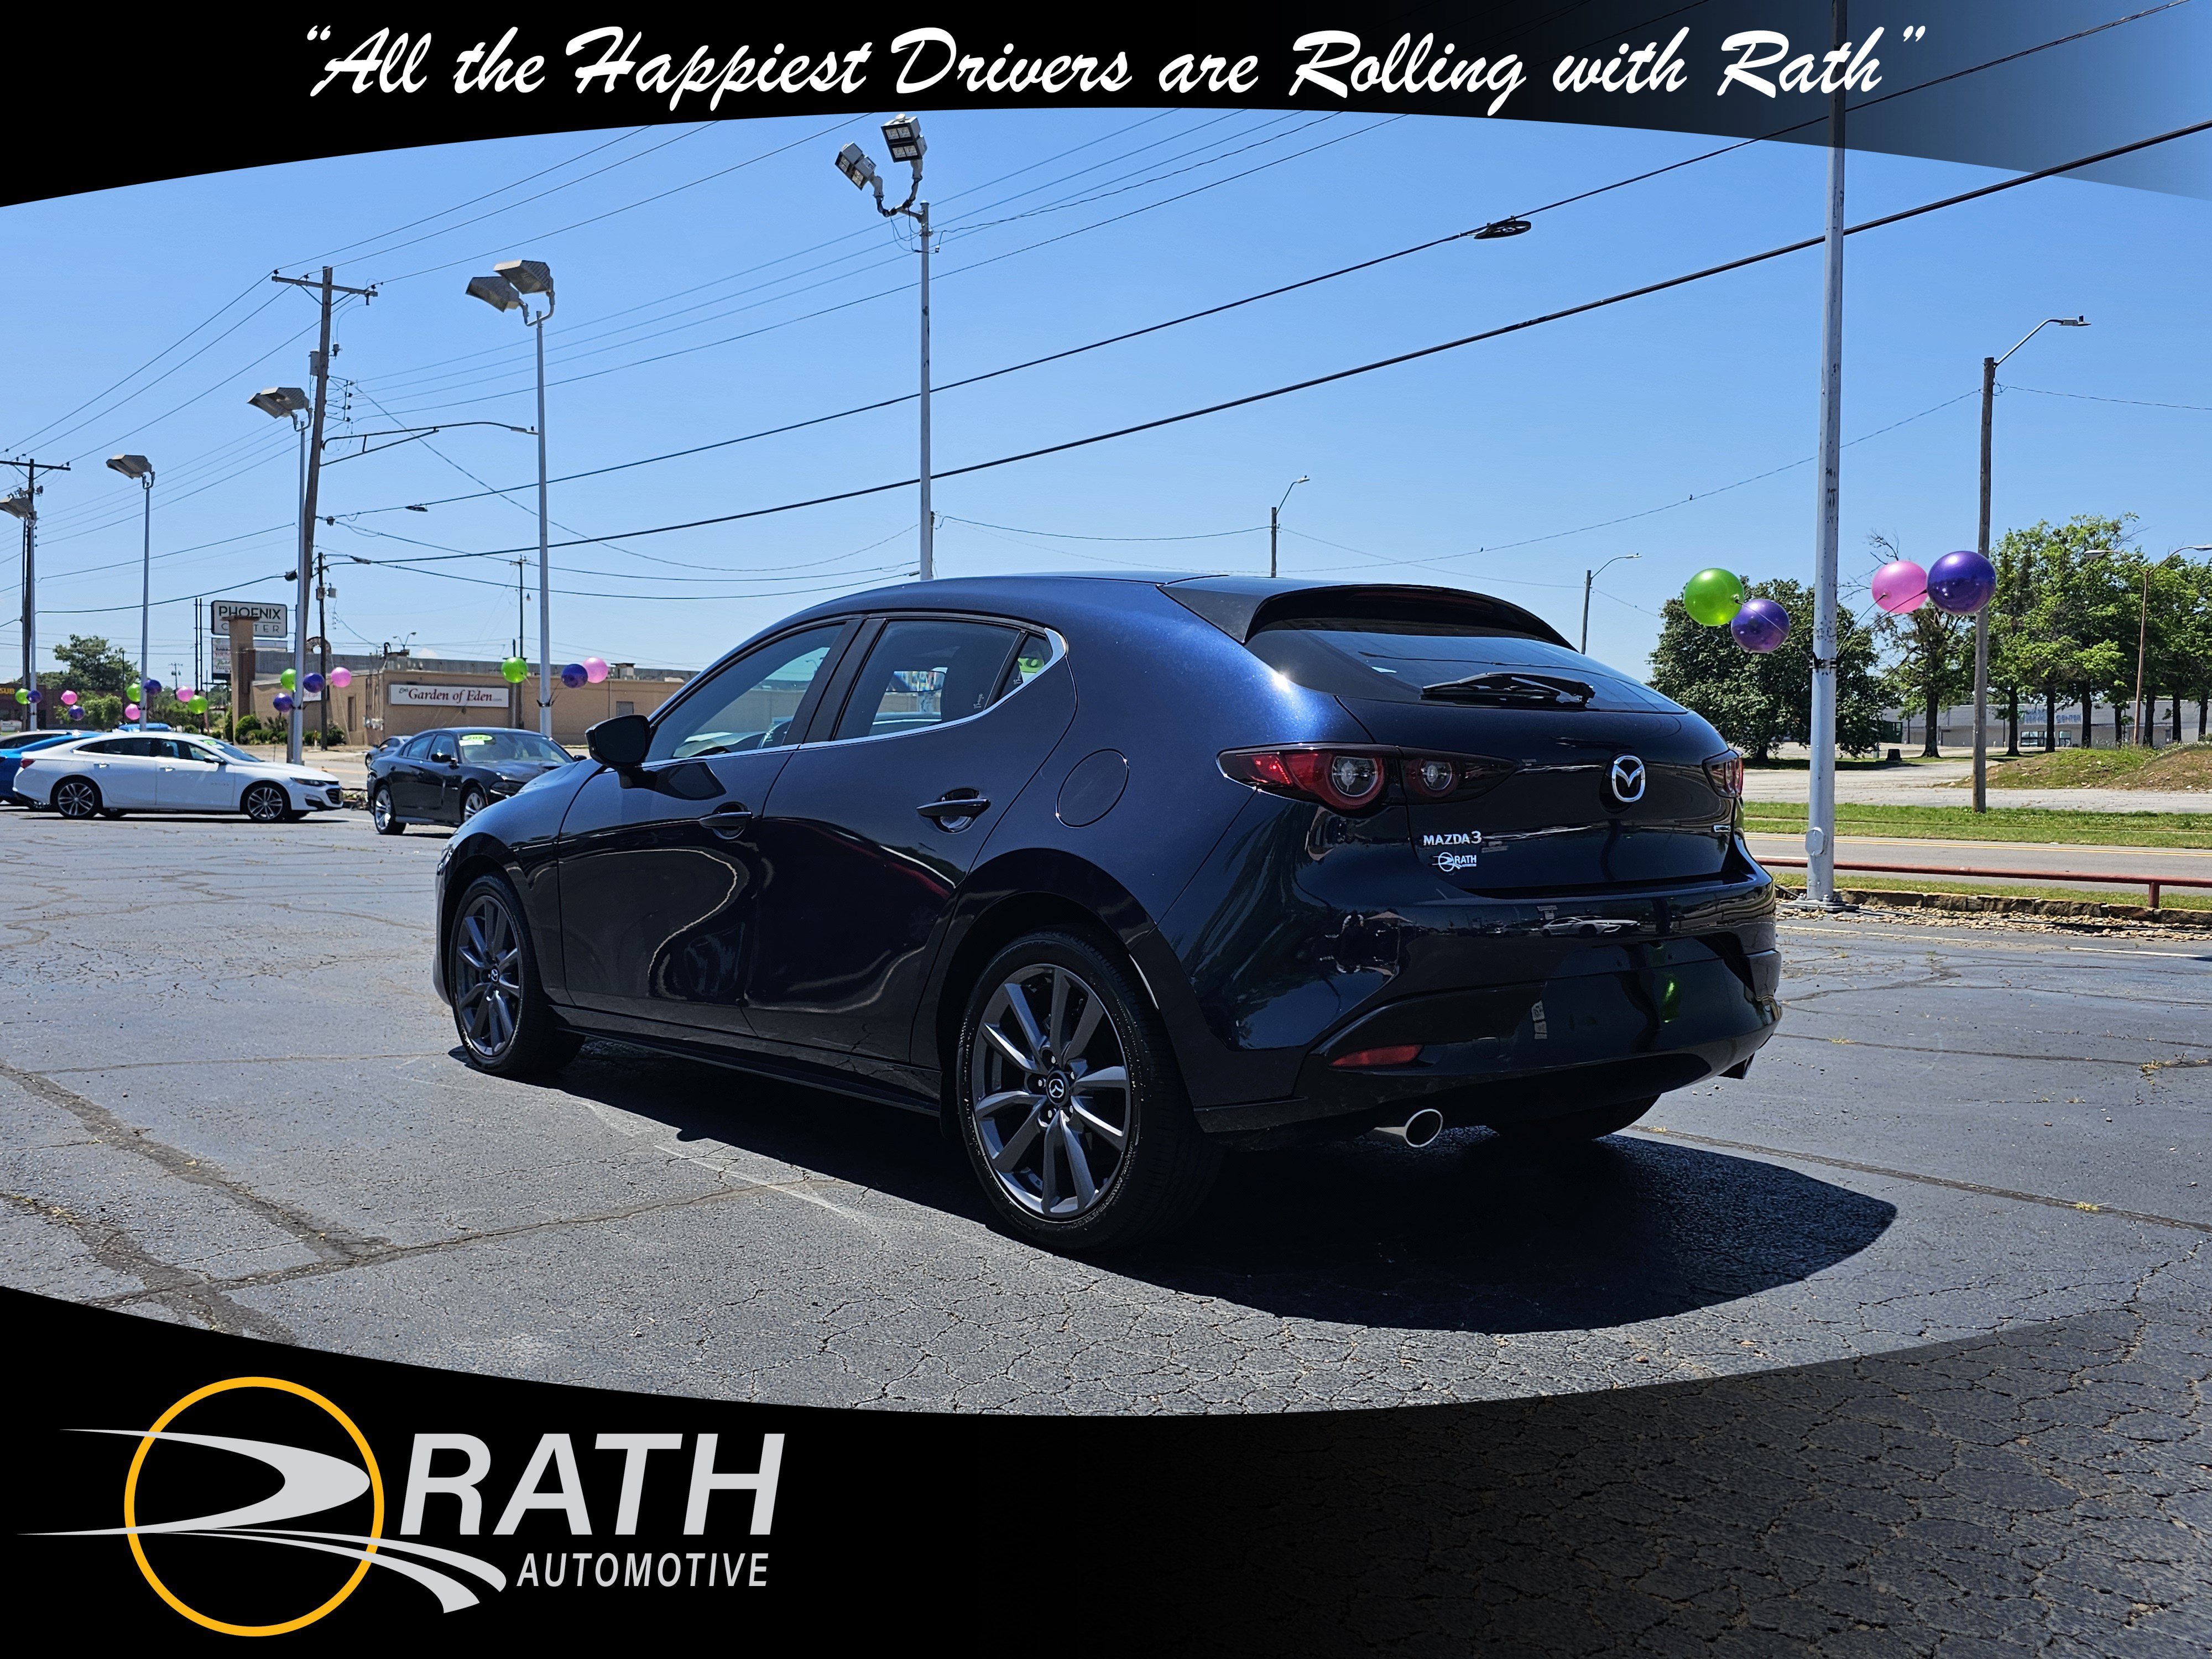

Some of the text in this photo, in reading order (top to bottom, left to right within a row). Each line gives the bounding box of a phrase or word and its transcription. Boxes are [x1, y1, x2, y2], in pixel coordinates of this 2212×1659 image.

[218, 606, 281, 620] PHOENIX
[221, 623, 279, 633] CTER
[408, 688, 448, 701] Garden
[452, 690, 465, 703] of
[467, 690, 492, 702] Eden
[1454, 854, 1477, 864] RATH
